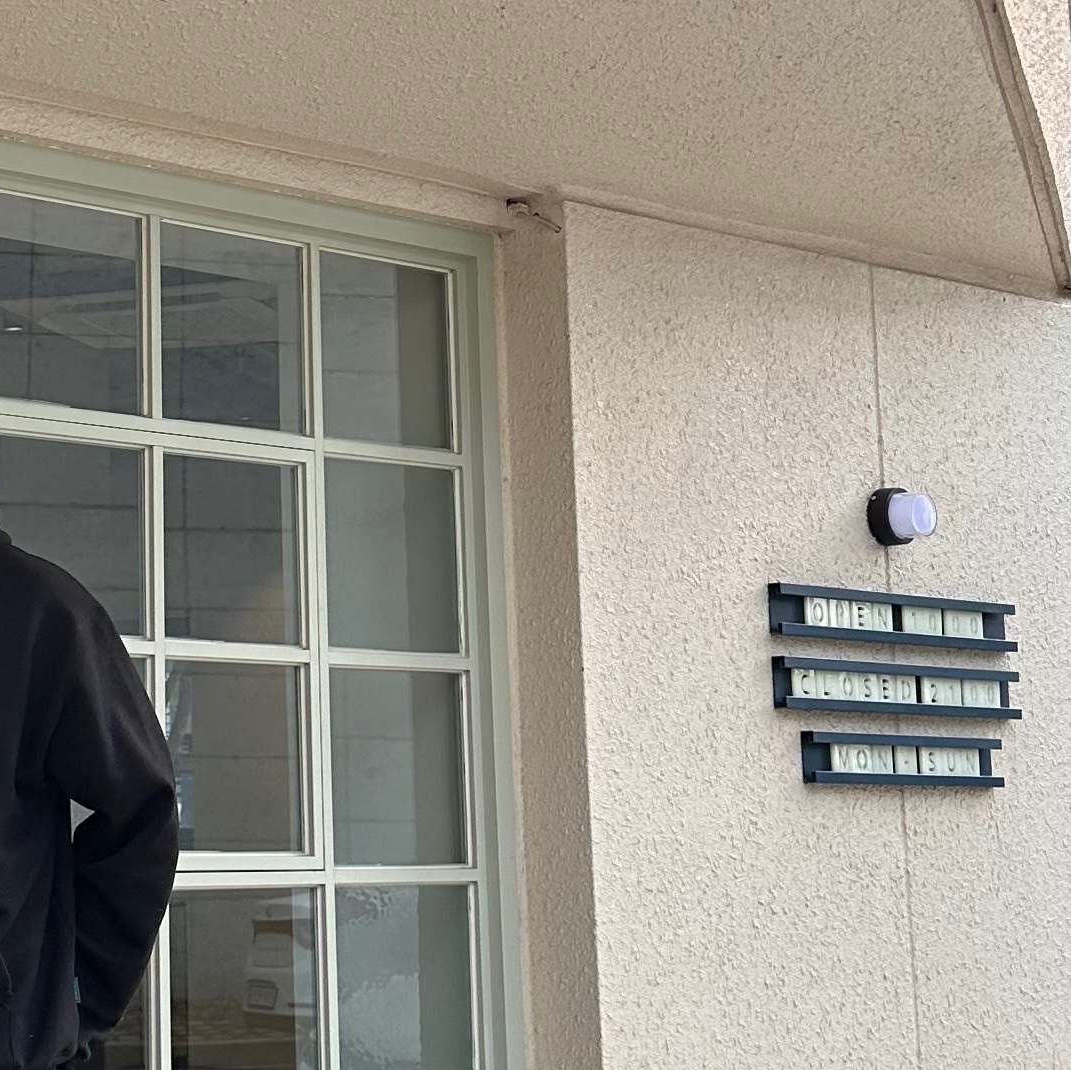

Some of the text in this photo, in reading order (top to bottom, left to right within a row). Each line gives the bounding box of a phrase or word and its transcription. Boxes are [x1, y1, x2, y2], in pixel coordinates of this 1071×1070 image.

[813, 602, 888, 630] OPEN
[801, 674, 910, 701] CLOSED
[838, 746, 887, 770] MON
[928, 752, 976, 773] SUN
